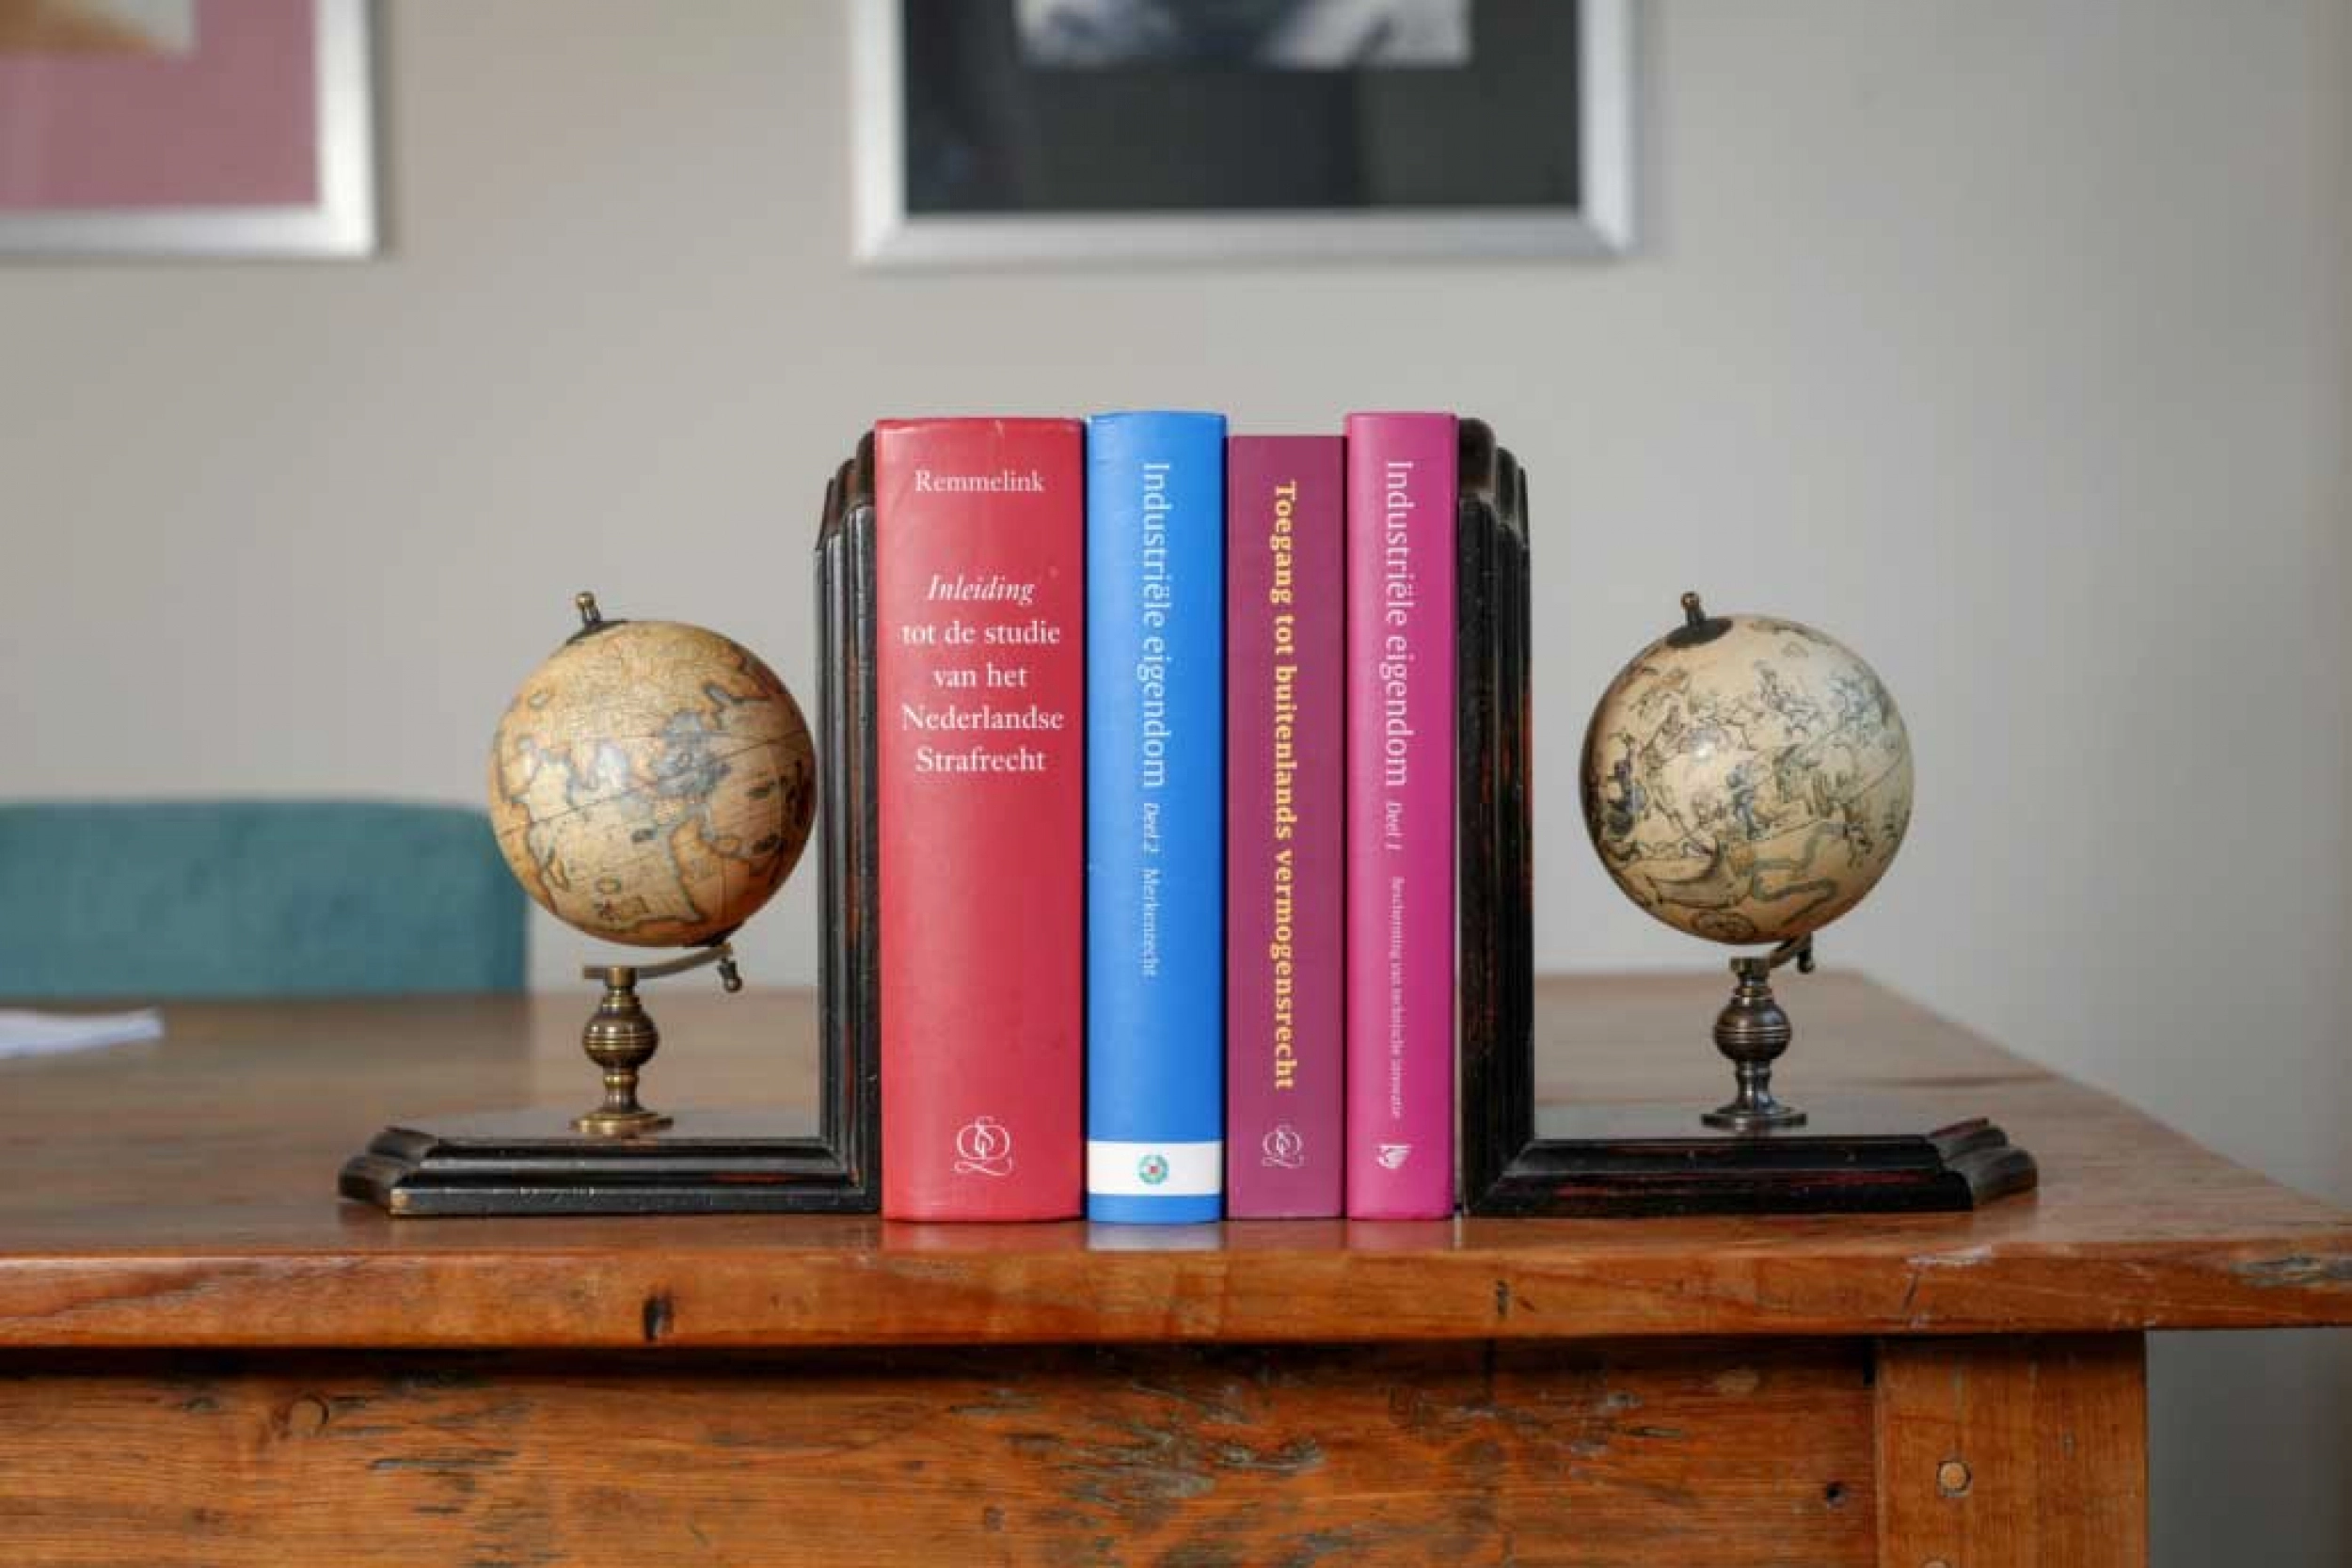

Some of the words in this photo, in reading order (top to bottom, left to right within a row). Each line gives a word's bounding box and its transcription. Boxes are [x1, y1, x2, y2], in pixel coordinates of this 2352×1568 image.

[914, 469, 1045, 493] Remmelink
[1142, 462, 1172, 628] Industriële
[1270, 479, 1297, 605] Toegang
[1386, 461, 1415, 627] Industriële
[927, 574, 1035, 607] Inleiding
[900, 622, 936, 644] tot
[944, 620, 976, 644] de
[984, 620, 1060, 644] studie
[1274, 614, 1295, 656] tot
[932, 667, 977, 688] van
[987, 662, 1028, 688] het
[901, 704, 1064, 730] Nederlandse
[1136, 636, 1172, 788] eigendom
[1379, 634, 1415, 786] eigendom
[914, 748, 1046, 773] Strafrecht
[1274, 665, 1298, 841] buitenlands
[1142, 802, 1162, 839] Deel
[1385, 802, 1404, 837] Deel
[1270, 848, 1297, 1089] vermogensrecht
